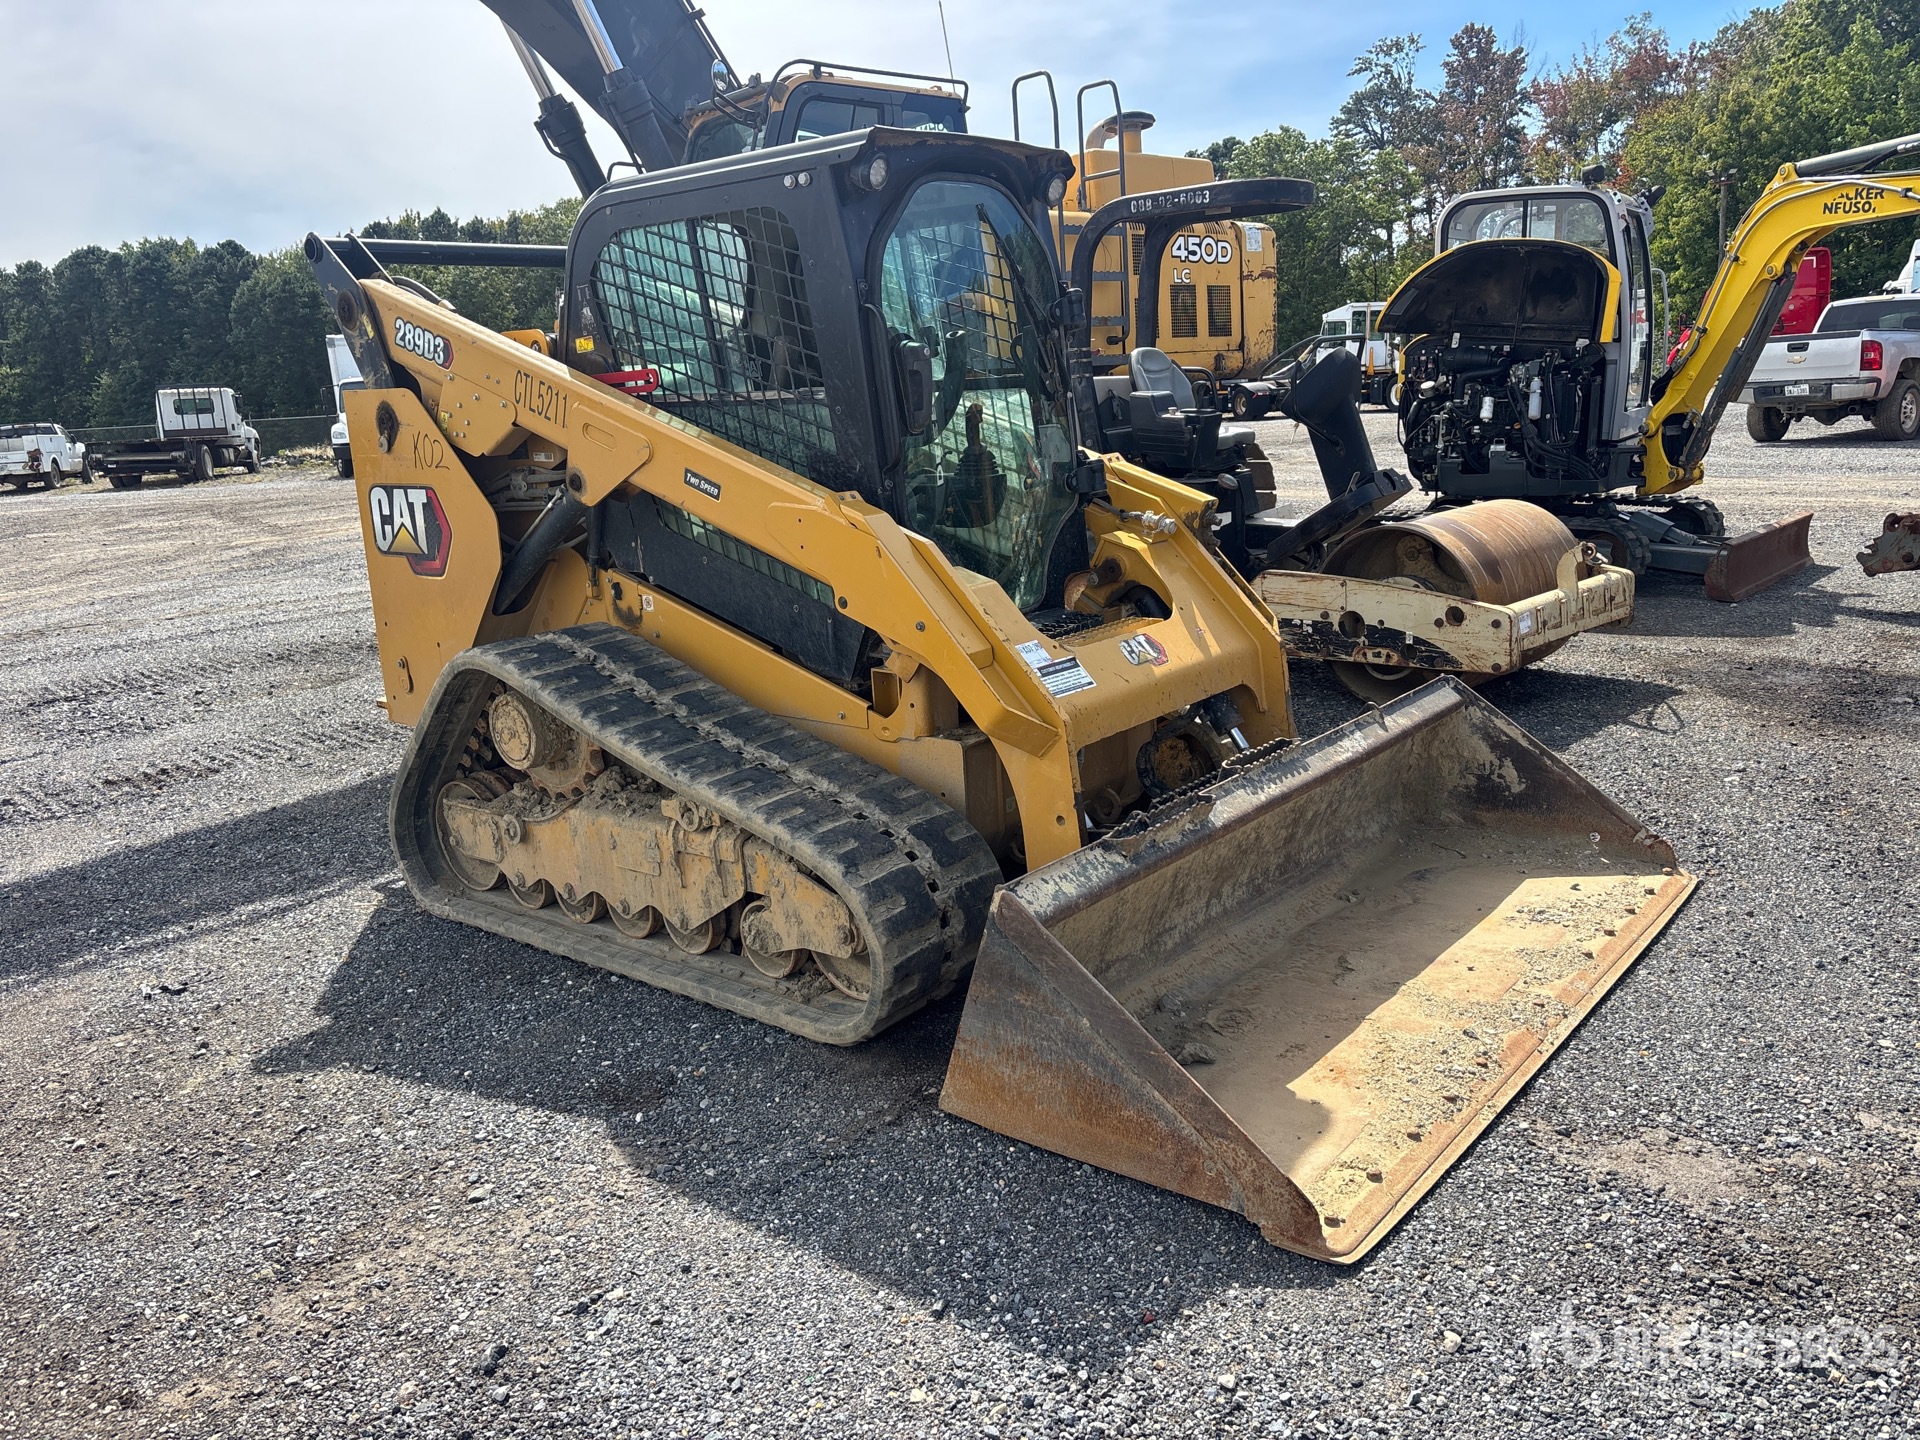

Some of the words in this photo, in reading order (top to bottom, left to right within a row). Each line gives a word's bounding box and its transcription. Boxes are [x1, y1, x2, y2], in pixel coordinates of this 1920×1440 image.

[1171, 235, 1232, 264] 450D
[1172, 268, 1191, 283] LC
[395, 317, 445, 366] 289D3
[514, 369, 568, 429] CTL5211
[412, 430, 450, 470] K02
[370, 486, 429, 555] CAT
[1120, 634, 1158, 665] CAT
